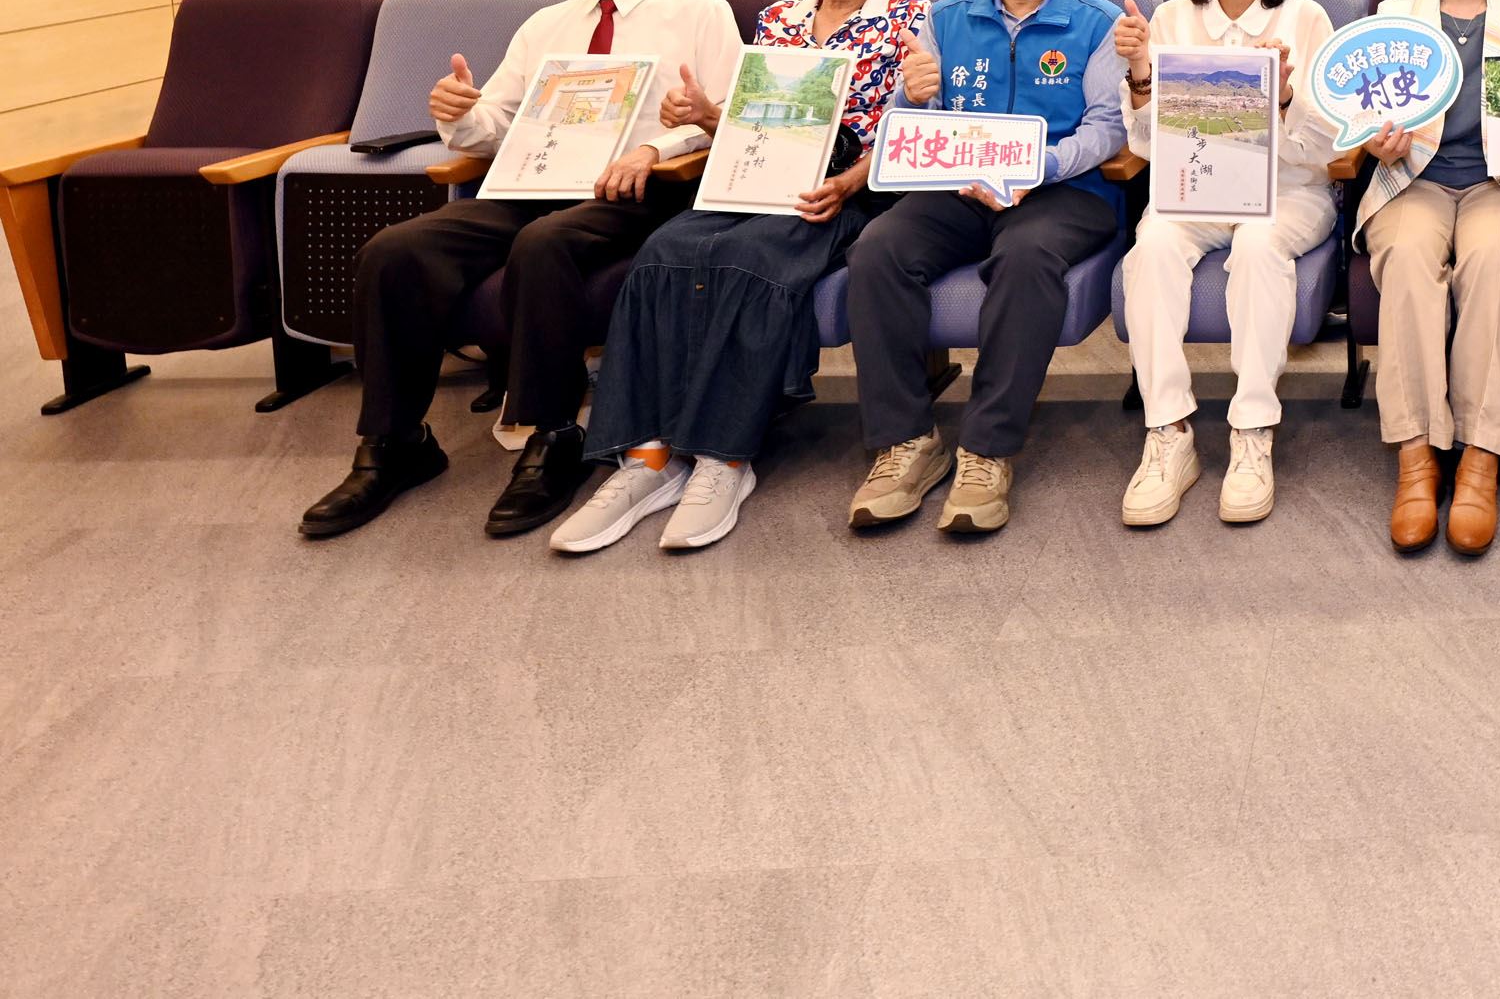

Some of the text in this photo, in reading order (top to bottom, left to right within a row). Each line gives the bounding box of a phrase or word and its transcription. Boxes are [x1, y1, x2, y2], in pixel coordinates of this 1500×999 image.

[972, 57, 990, 108] 副局長
[1355, 65, 1430, 110] 村史
[888, 125, 1032, 170] 村史出書啦!
